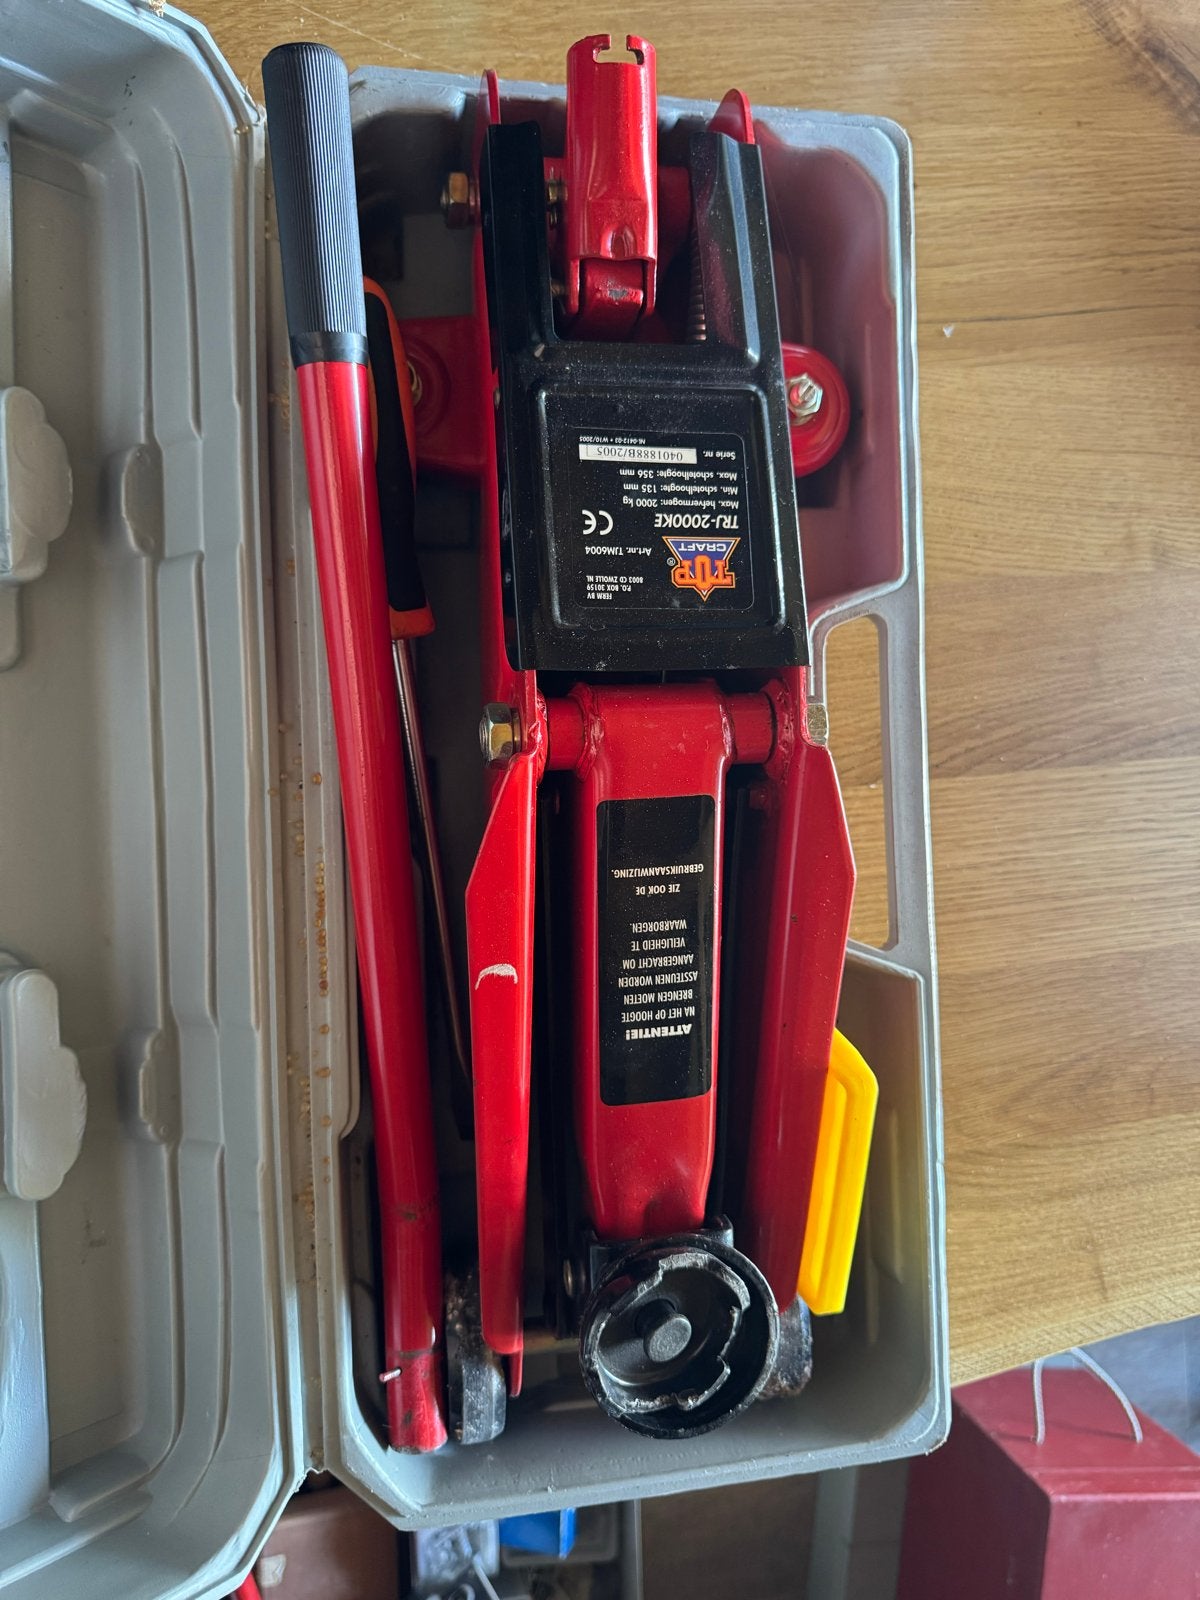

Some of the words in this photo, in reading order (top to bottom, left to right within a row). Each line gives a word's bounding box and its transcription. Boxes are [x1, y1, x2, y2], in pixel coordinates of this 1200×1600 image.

[597, 447, 682, 461] 0401888B/2005
[715, 451, 736, 459] Serie
[638, 470, 653, 478] 356
[657, 468, 713, 480] schotelhoogte:
[717, 472, 737, 480] Max.
[661, 482, 718, 494] schotelhoogte:
[622, 496, 634, 506] kg
[636, 499, 658, 507] 2000
[660, 498, 716, 508] hefvermogen:
[718, 500, 739, 508] Max.
[582, 510, 613, 535] CE
[654, 513, 738, 528] TRJ-2000KE
[585, 546, 623, 555] TJM6004
[626, 547, 652, 555] Art.nr.
[678, 542, 727, 552] CRAFT
[672, 555, 733, 591] TOP
[611, 863, 704, 878] GEBRUIKSAANWIJZING.
[636, 886, 646, 895] DE
[648, 885, 666, 894] OOK
[668, 884, 680, 893] ZIE
[630, 919, 687, 933] WAARBORGEN.
[631, 941, 640, 951] TE
[643, 937, 685, 950] VEILIGHEID
[622, 959, 635, 969] OM
[638, 953, 694, 968] AANGEBRACHT
[618, 974, 653, 988] WORDEN
[655, 970, 698, 985] ASSTEUNEN
[624, 992, 655, 1004] MOETEN
[658, 989, 693, 1002] BRENGEN
[621, 1010, 653, 1022] HOOGTE
[655, 1009, 666, 1020] OP
[668, 1008, 682, 1019] HET
[684, 1006, 695, 1018] NA
[625, 1024, 692, 1040] ATTENTIE!
